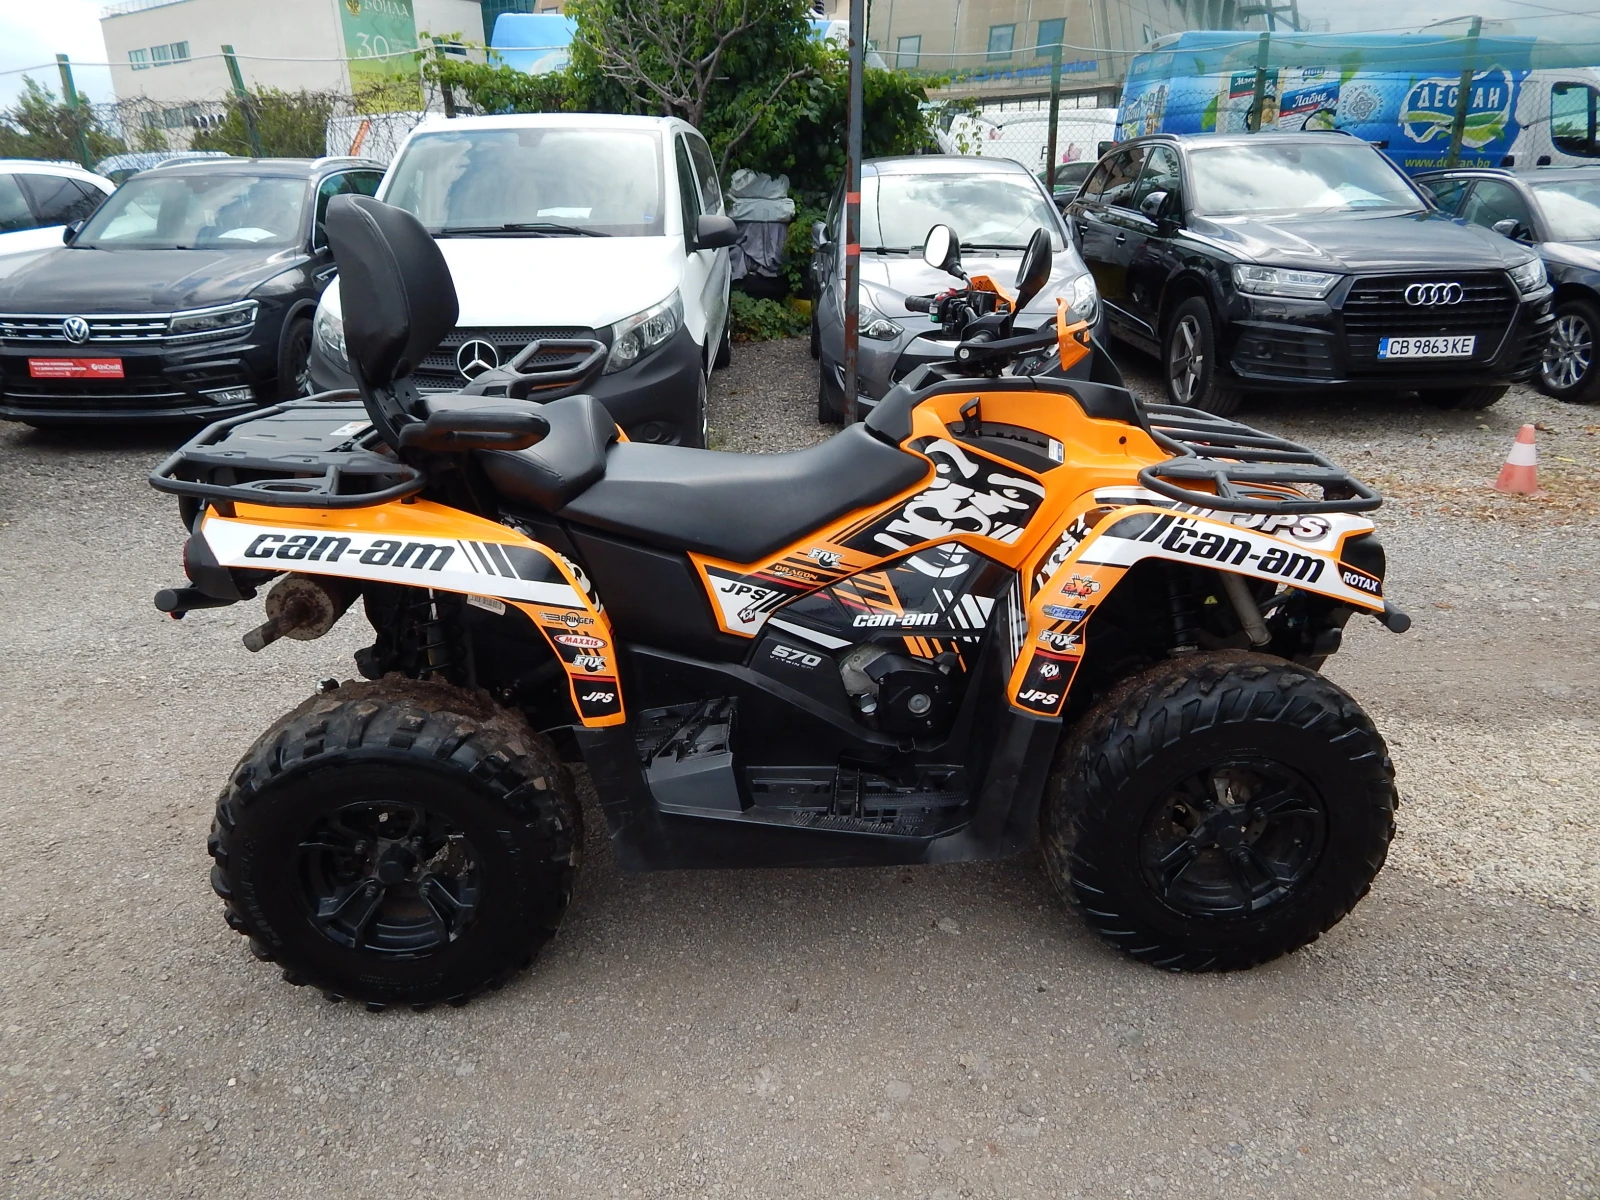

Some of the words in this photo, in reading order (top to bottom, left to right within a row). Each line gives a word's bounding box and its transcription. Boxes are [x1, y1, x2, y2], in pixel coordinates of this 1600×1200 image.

[356, 32, 390, 63] 30
[1292, 92, 1328, 108] Лабне
[1417, 86, 1501, 108] ДЕСАН
[1404, 156, 1491, 168] www.dean.bg
[1413, 339, 1449, 355] 9863
[1451, 338, 1472, 353] KE
[244, 533, 456, 572] can-am
[808, 548, 843, 567] FOX
[1162, 526, 1325, 584] can-am
[774, 565, 819, 580] DRAGON
[1342, 571, 1379, 593] ROTAX
[720, 583, 769, 600] JPS
[853, 612, 939, 628] can-am
[564, 636, 599, 646] MAXXIS
[1039, 630, 1079, 649] FOX
[573, 654, 607, 671] FOX
[771, 645, 822, 667] 570
[581, 691, 615, 703] JPS
[1018, 688, 1060, 705] JPS
